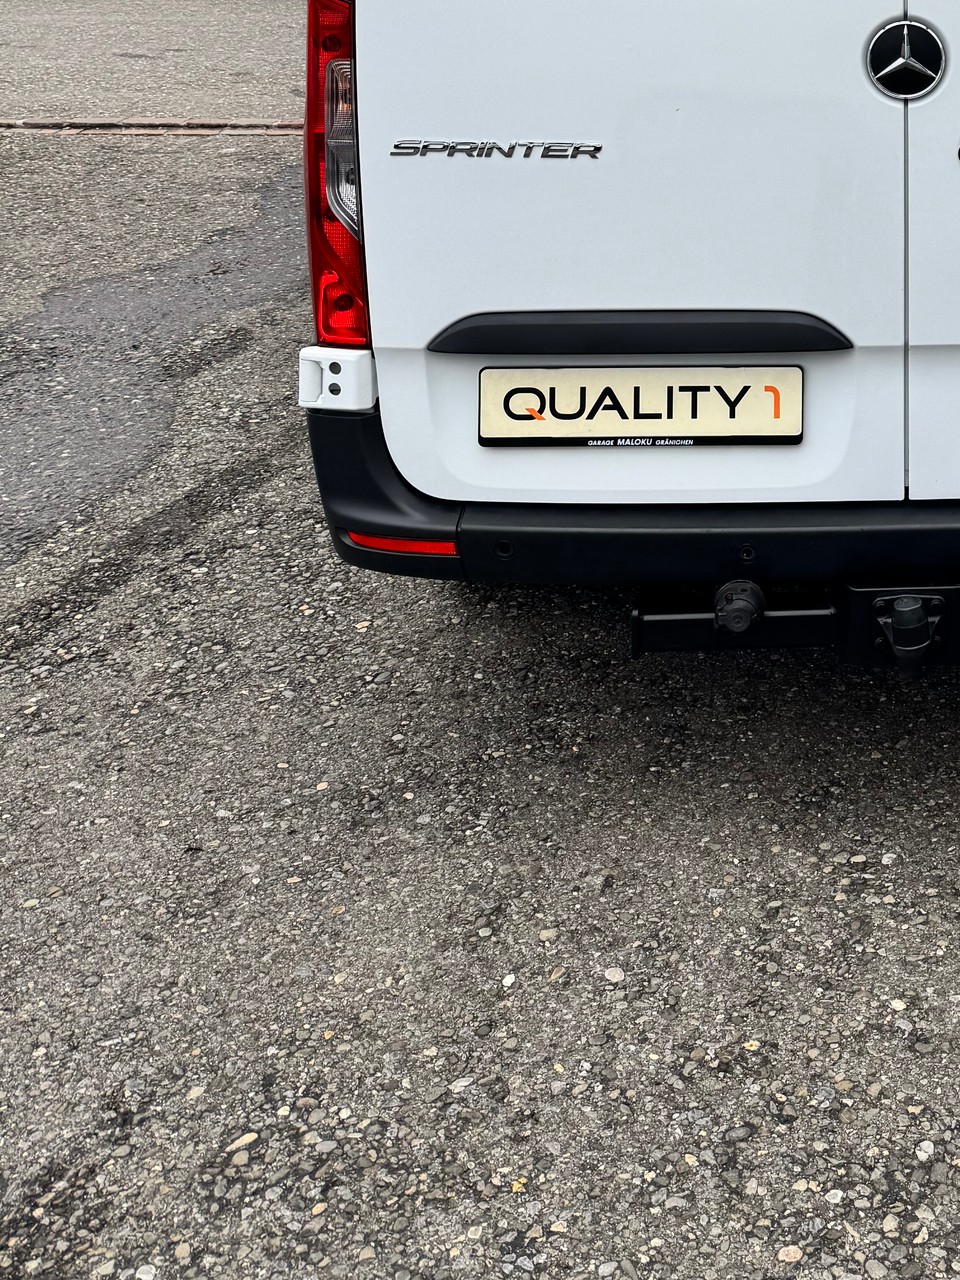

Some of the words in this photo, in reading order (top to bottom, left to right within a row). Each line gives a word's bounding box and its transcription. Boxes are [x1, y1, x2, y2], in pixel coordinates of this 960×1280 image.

[390, 139, 602, 160] SPRINTER
[503, 385, 751, 420] QUALITY
[764, 385, 781, 419] 1
[617, 438, 653, 446] MALOKU
[655, 438, 694, 446] GRÄNICHEN
